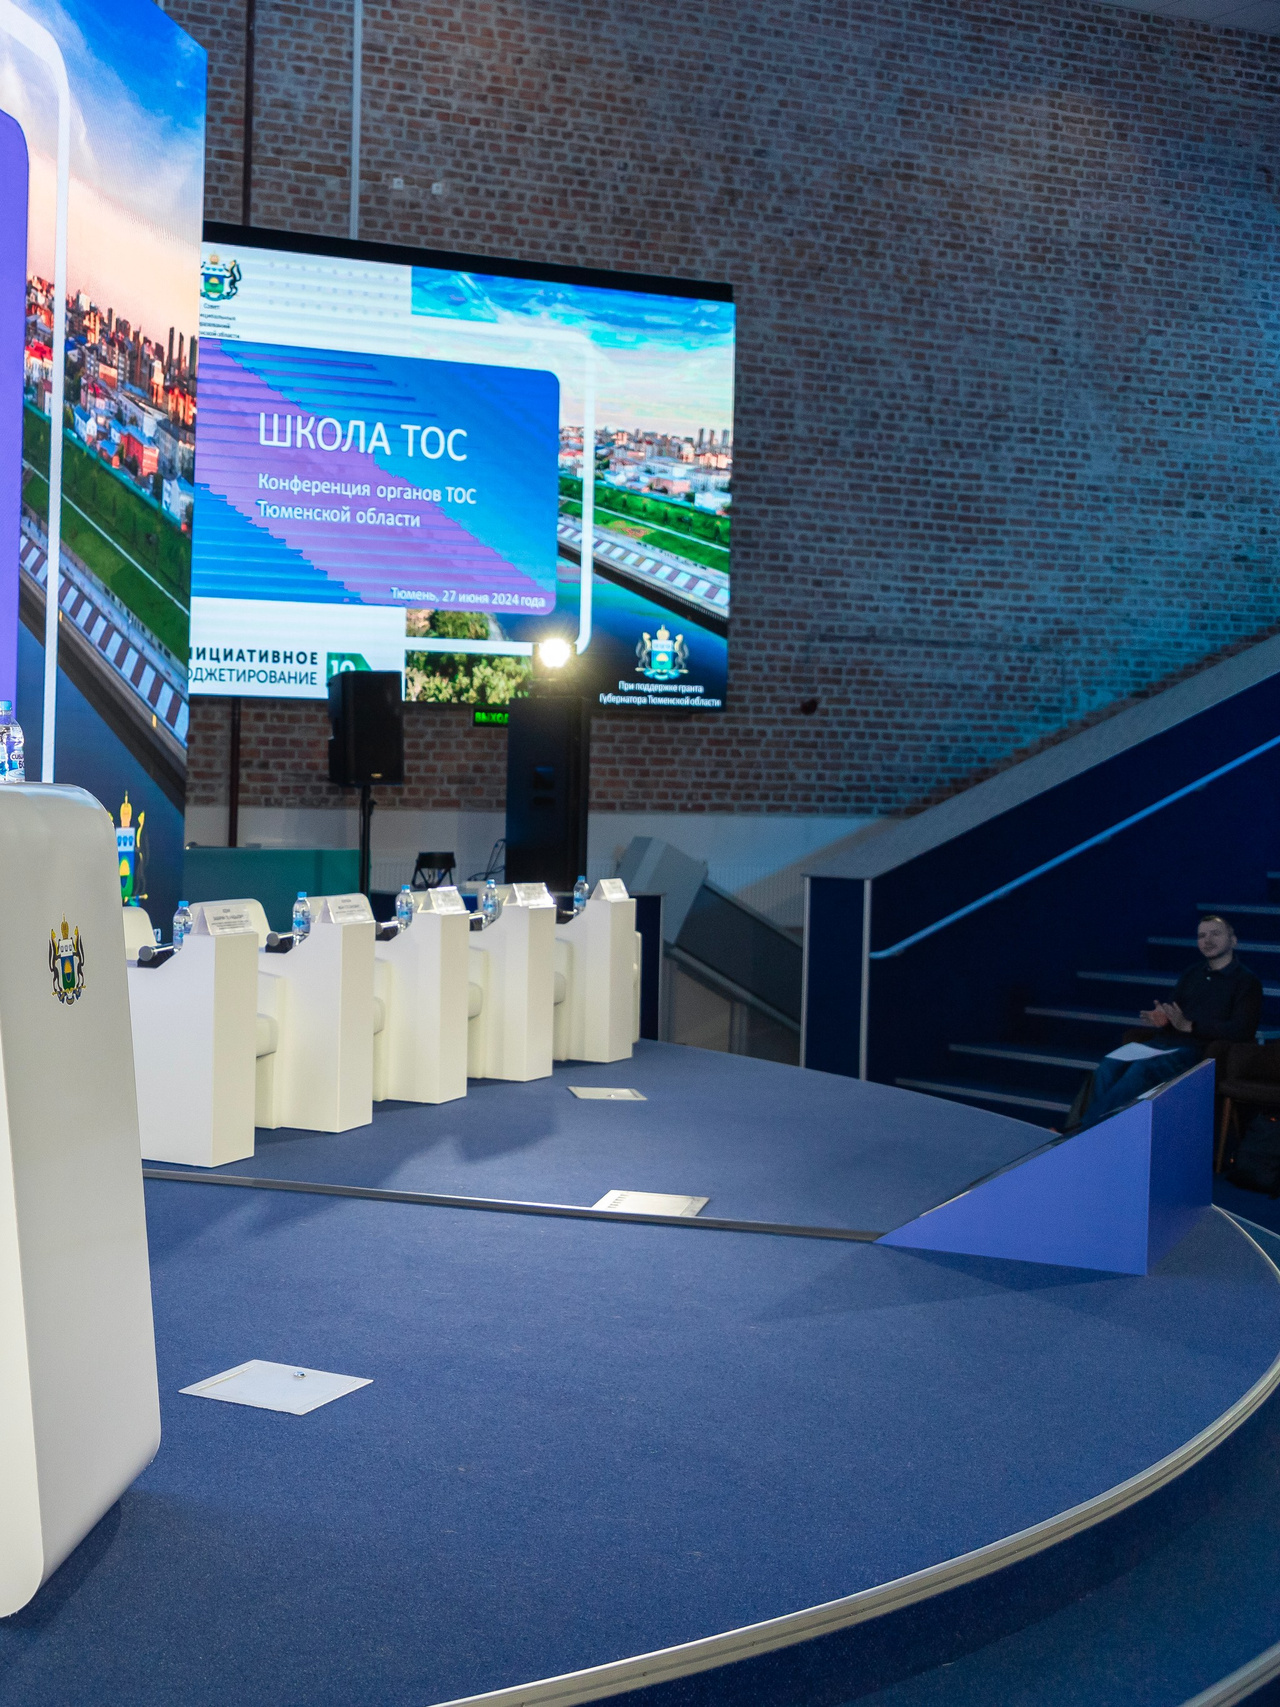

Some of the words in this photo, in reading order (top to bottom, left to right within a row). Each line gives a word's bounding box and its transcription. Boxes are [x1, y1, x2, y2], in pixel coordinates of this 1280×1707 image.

[258, 412, 392, 456] ШКОЛА
[401, 423, 468, 462] ТОС
[257, 473, 370, 499] Конференция
[376, 485, 442, 502] органов
[445, 486, 478, 505] ТОС
[257, 500, 352, 523] Тюменской
[356, 507, 421, 527] области
[390, 587, 440, 603] Тюмень,
[442, 590, 457, 602] 27
[458, 593, 489, 604] июня
[491, 593, 519, 606] 2024
[520, 595, 546, 608] года
[618, 680, 635, 692] При
[635, 682, 678, 693] поддержке
[599, 692, 647, 705] Губернатора
[690, 696, 722, 707] области
